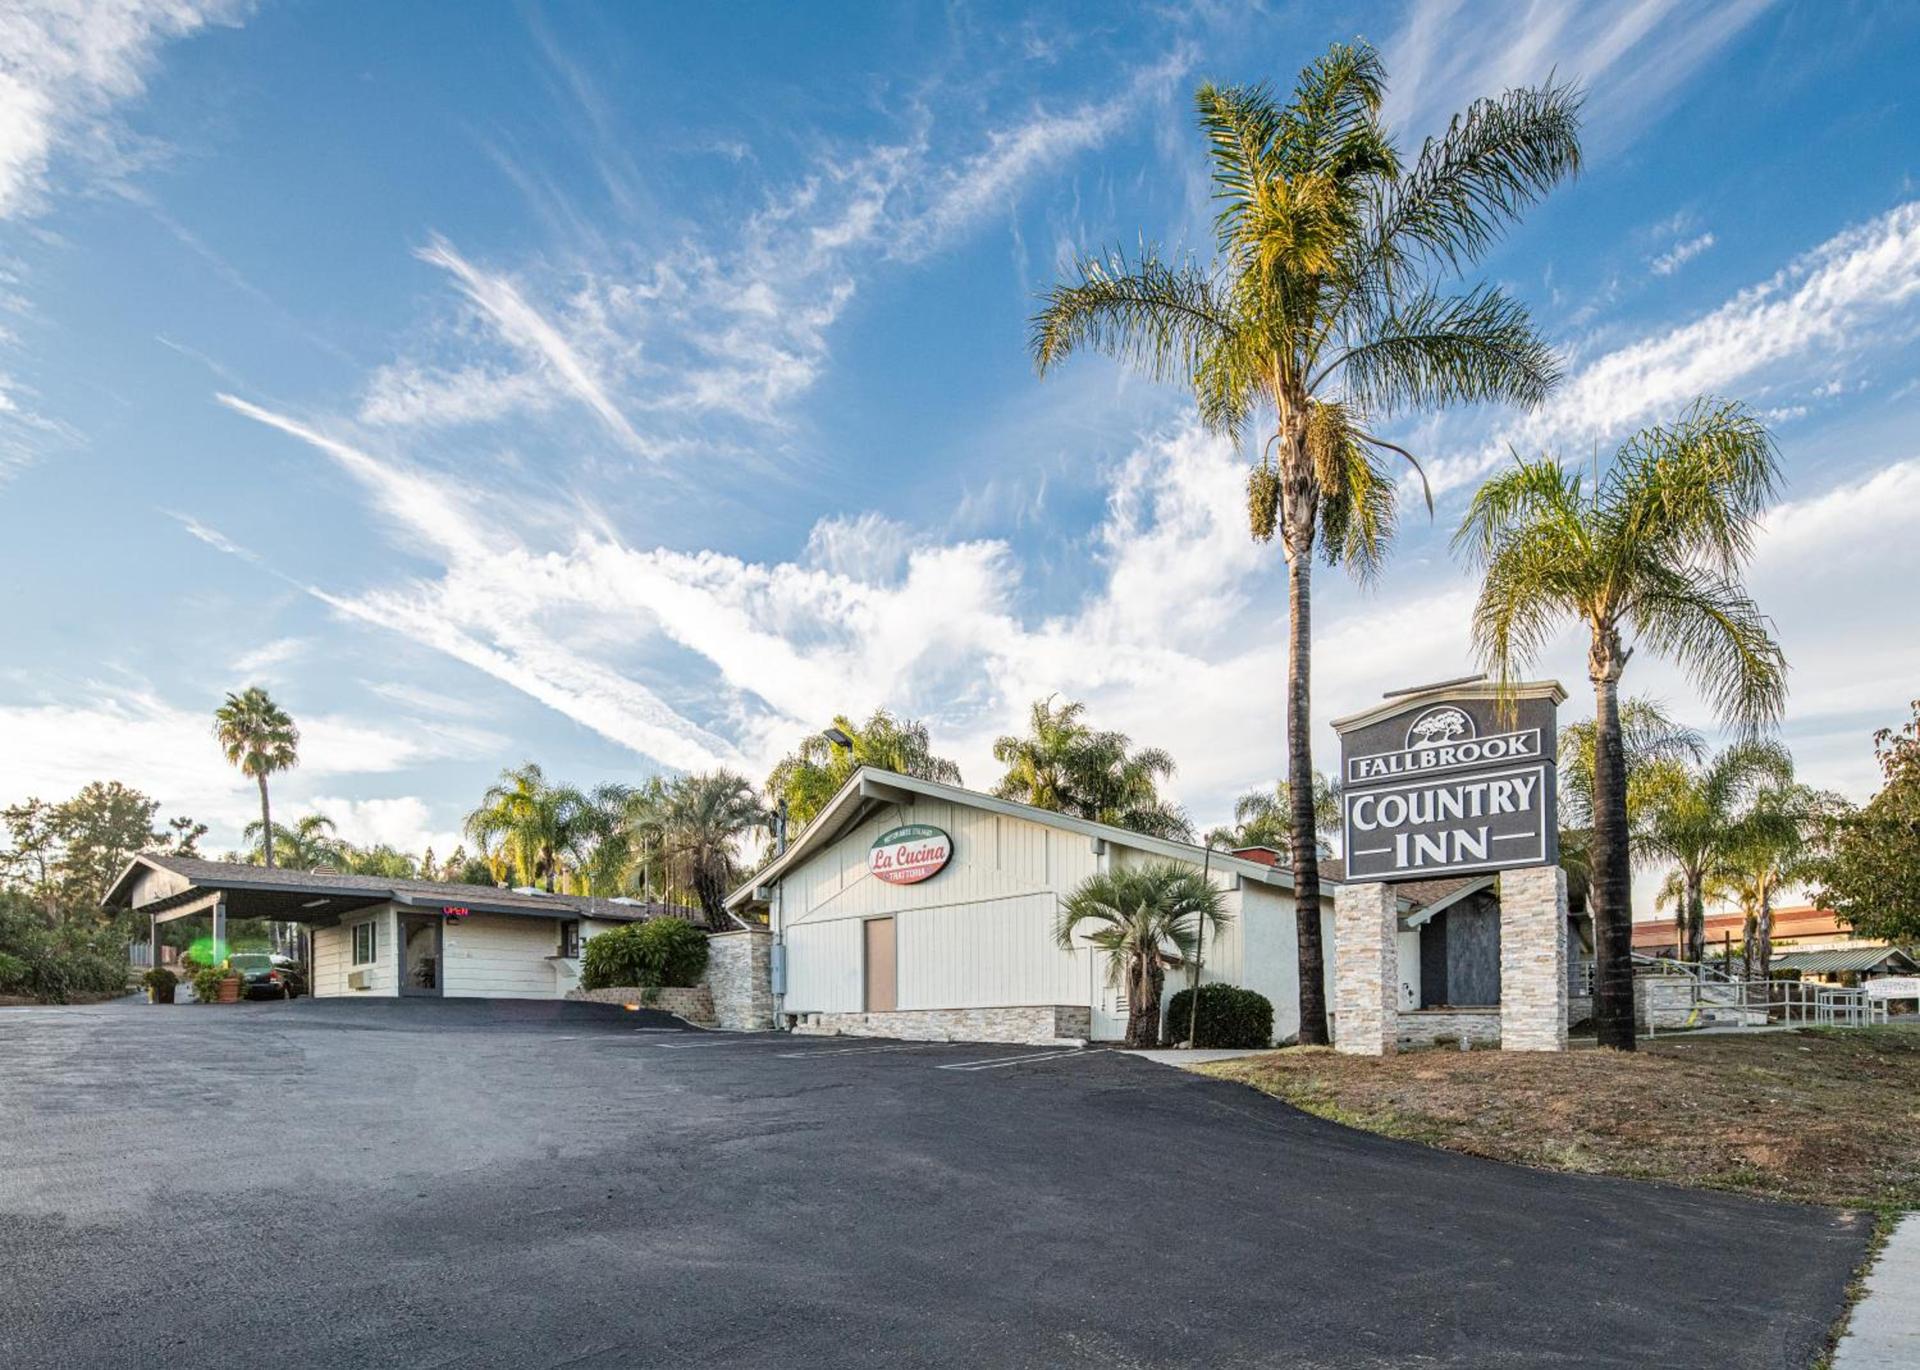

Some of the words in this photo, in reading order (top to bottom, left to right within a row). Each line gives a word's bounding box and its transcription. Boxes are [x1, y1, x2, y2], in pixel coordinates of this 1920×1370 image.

[1359, 735, 1530, 778] FALLBROOK
[1352, 776, 1537, 831] COUNTRY
[873, 849, 893, 870] La
[896, 844, 946, 866] Cucina
[1394, 826, 1490, 868] INN
[442, 905, 469, 916] OPEN
